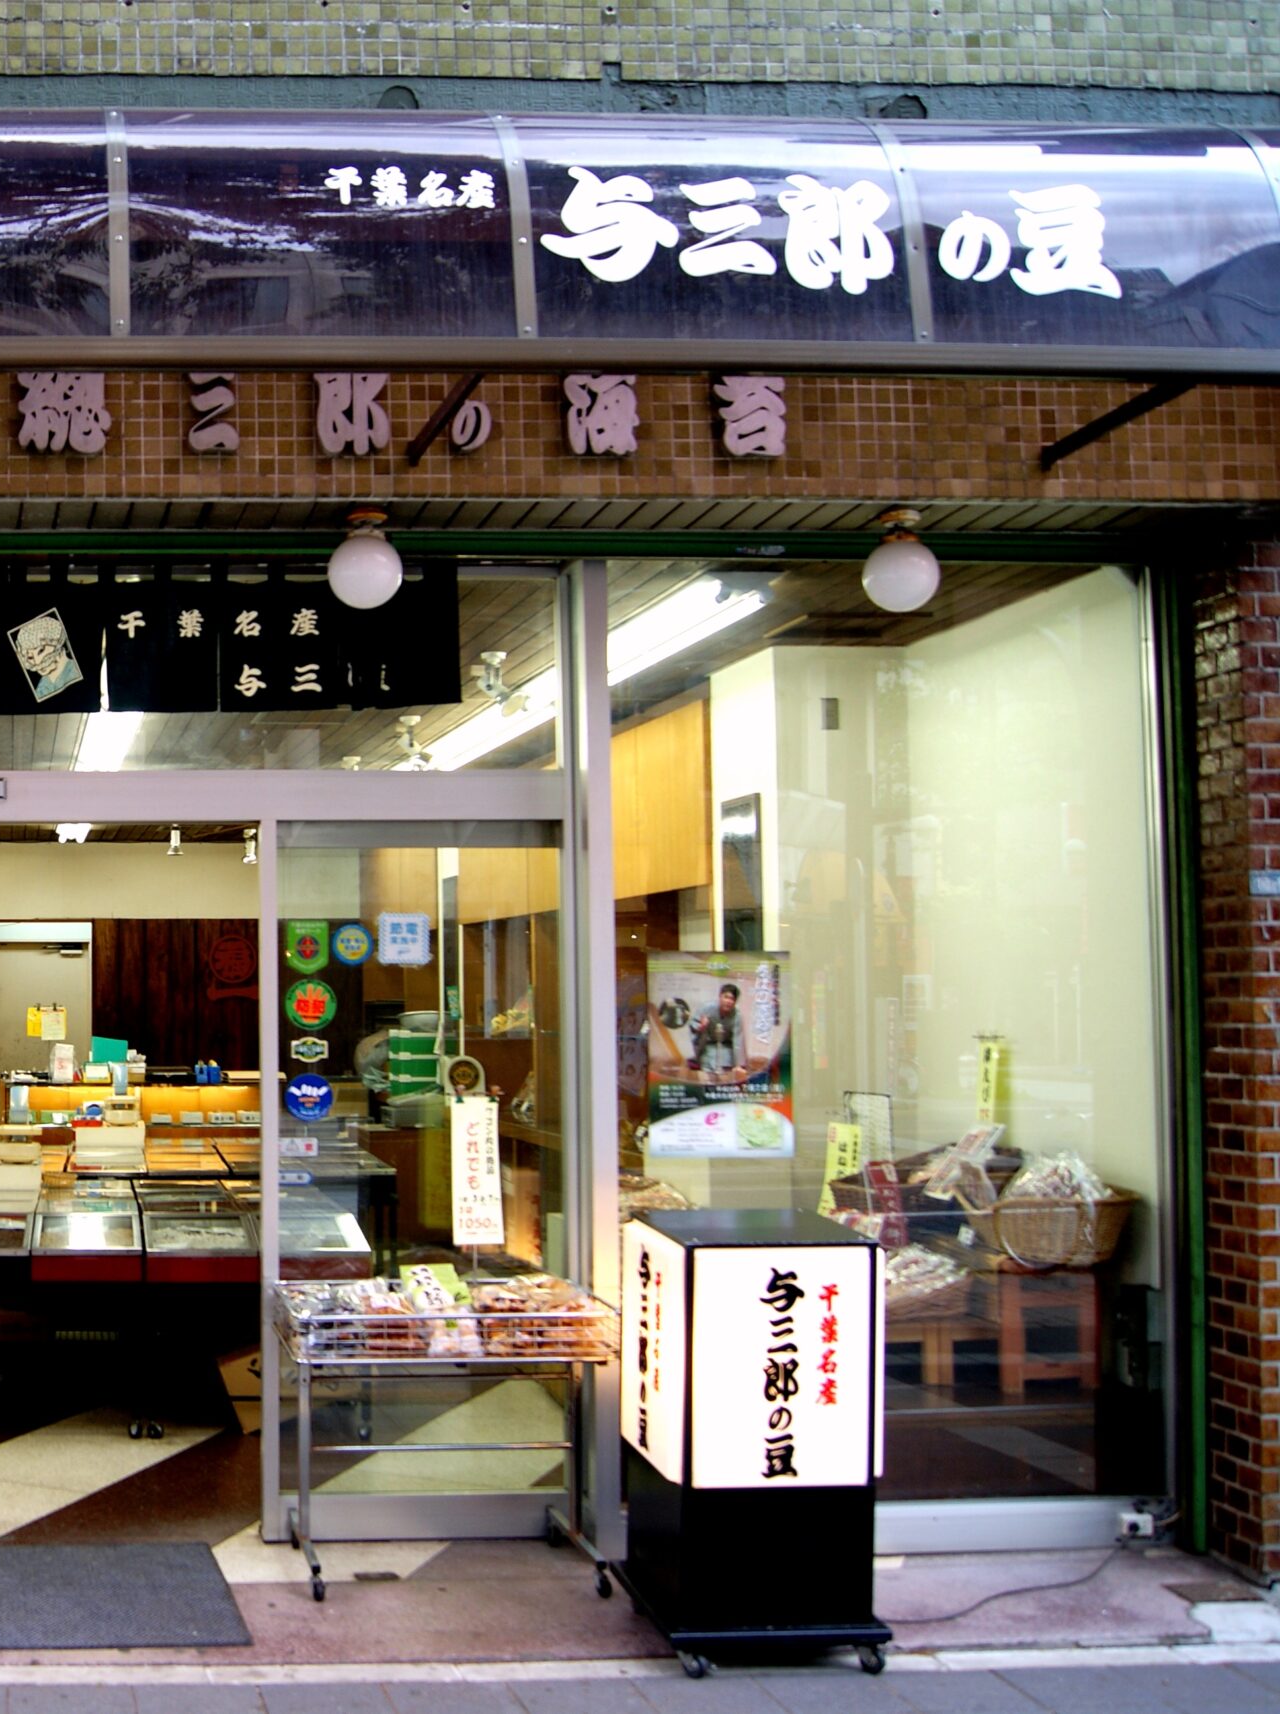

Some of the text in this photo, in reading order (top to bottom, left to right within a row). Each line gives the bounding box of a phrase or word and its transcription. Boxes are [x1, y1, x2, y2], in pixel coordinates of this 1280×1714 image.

[324, 165, 497, 209] 千葉名産
[540, 165, 1122, 299] 与三郎の豆
[118, 609, 320, 638] 千葉名産
[466, 1121, 480, 1190] どれでも
[761, 1268, 804, 1478] 与三郎の豆
[816, 1283, 839, 1406] 千葉名産
